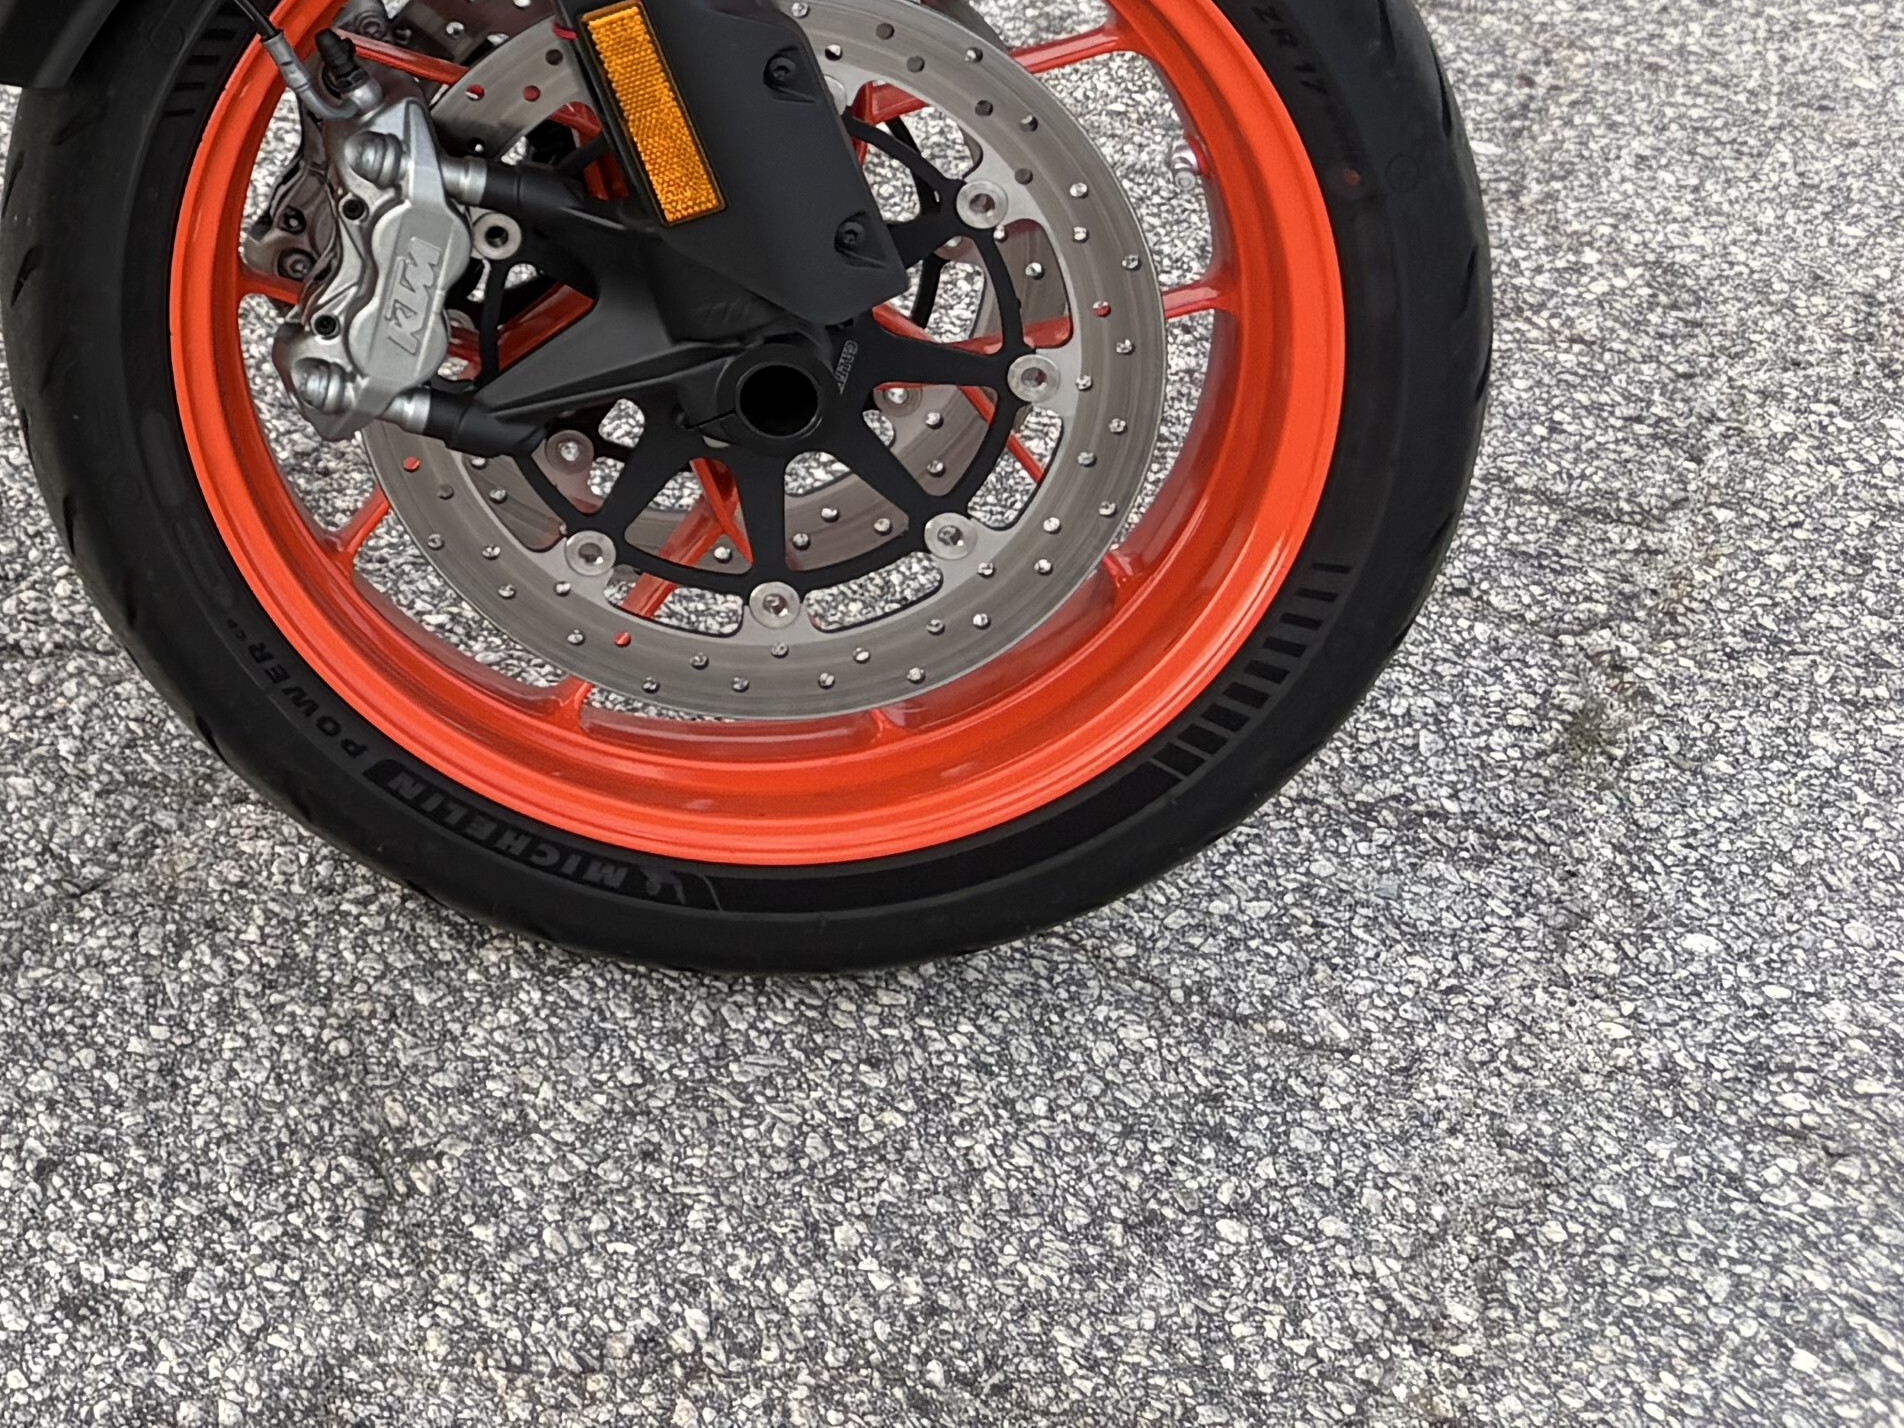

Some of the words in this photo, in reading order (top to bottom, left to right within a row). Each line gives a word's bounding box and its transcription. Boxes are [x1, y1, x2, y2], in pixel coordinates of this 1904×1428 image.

[1252, 4, 1299, 55] ZR
[1294, 60, 1325, 97] 17
[384, 235, 442, 357] KTM
[246, 641, 369, 757] POWER
[387, 772, 629, 893] MICHELIN
